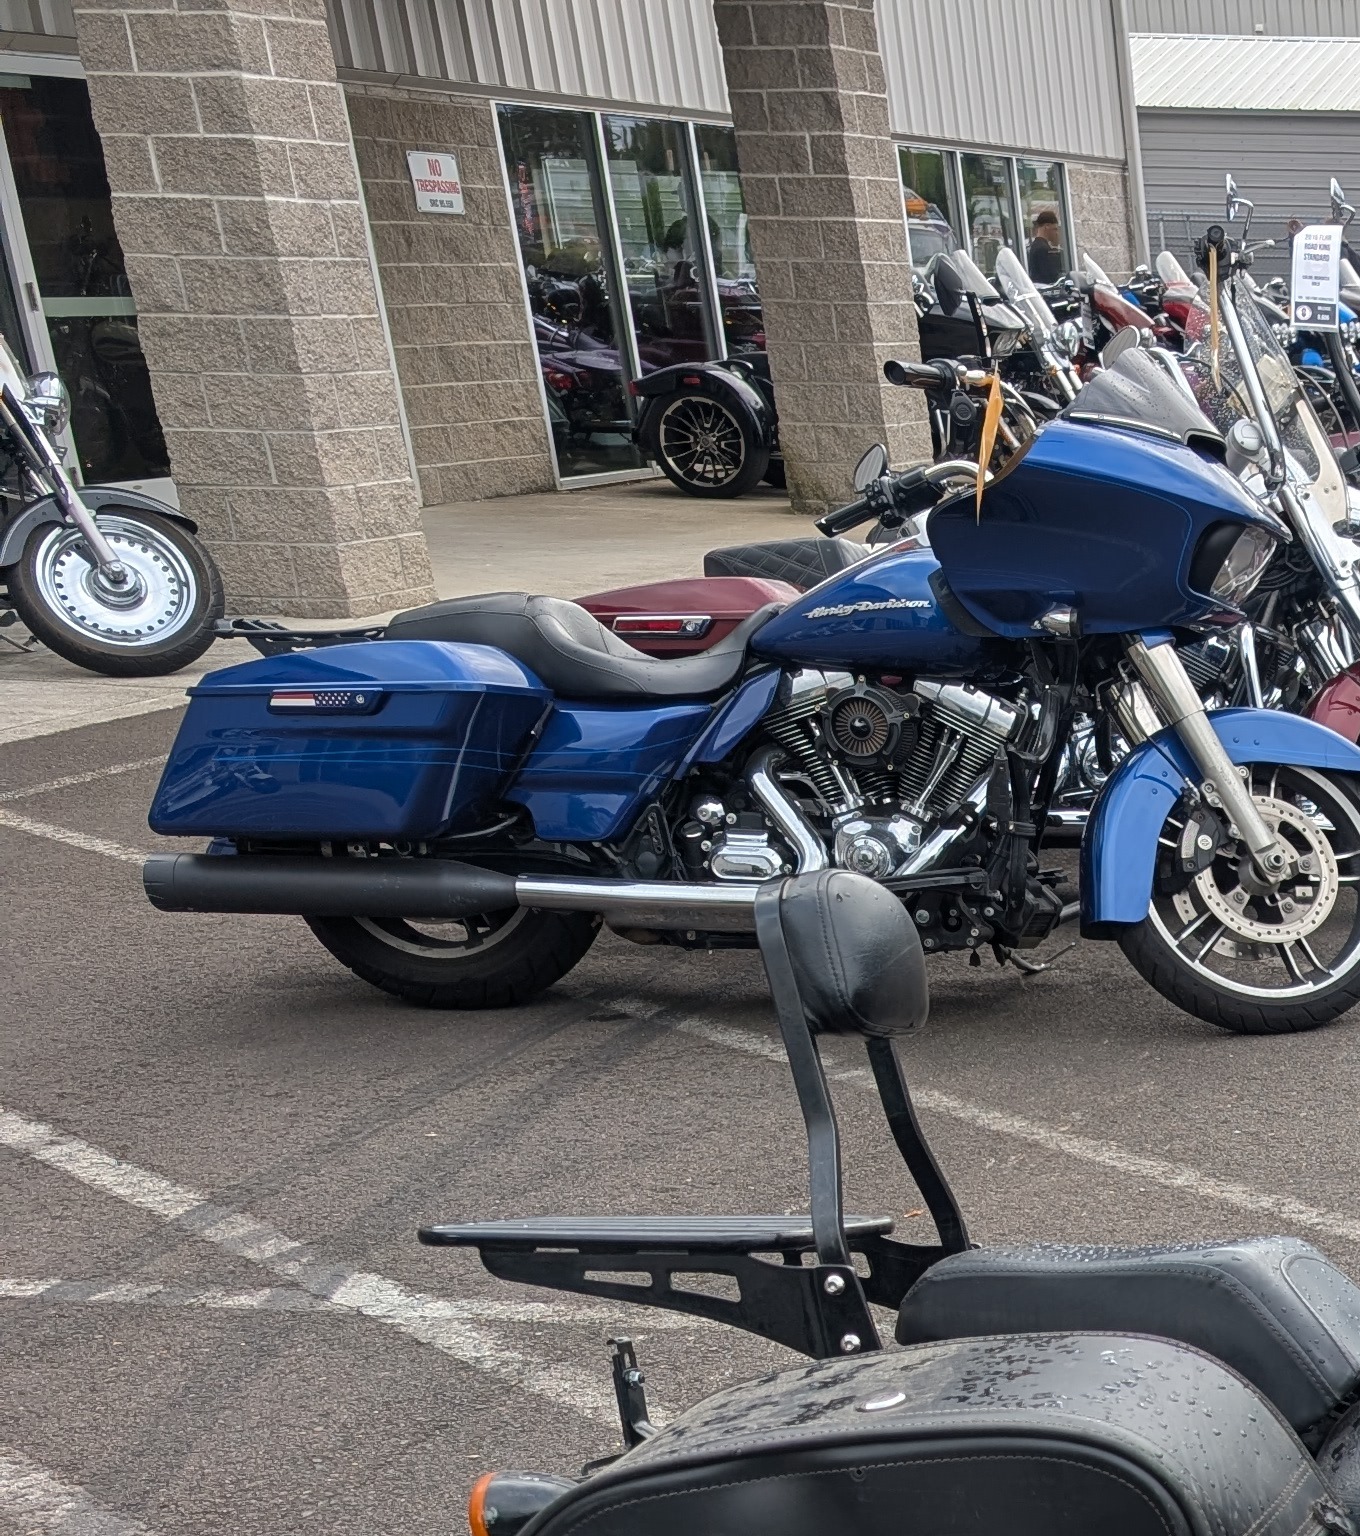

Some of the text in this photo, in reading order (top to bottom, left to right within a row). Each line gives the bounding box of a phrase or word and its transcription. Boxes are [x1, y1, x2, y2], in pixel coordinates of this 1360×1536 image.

[427, 158, 442, 177] NO
[414, 178, 461, 195] TRESPASSING
[1304, 243, 1331, 251] ROAD KING
[1303, 253, 1330, 262] STANDARD
